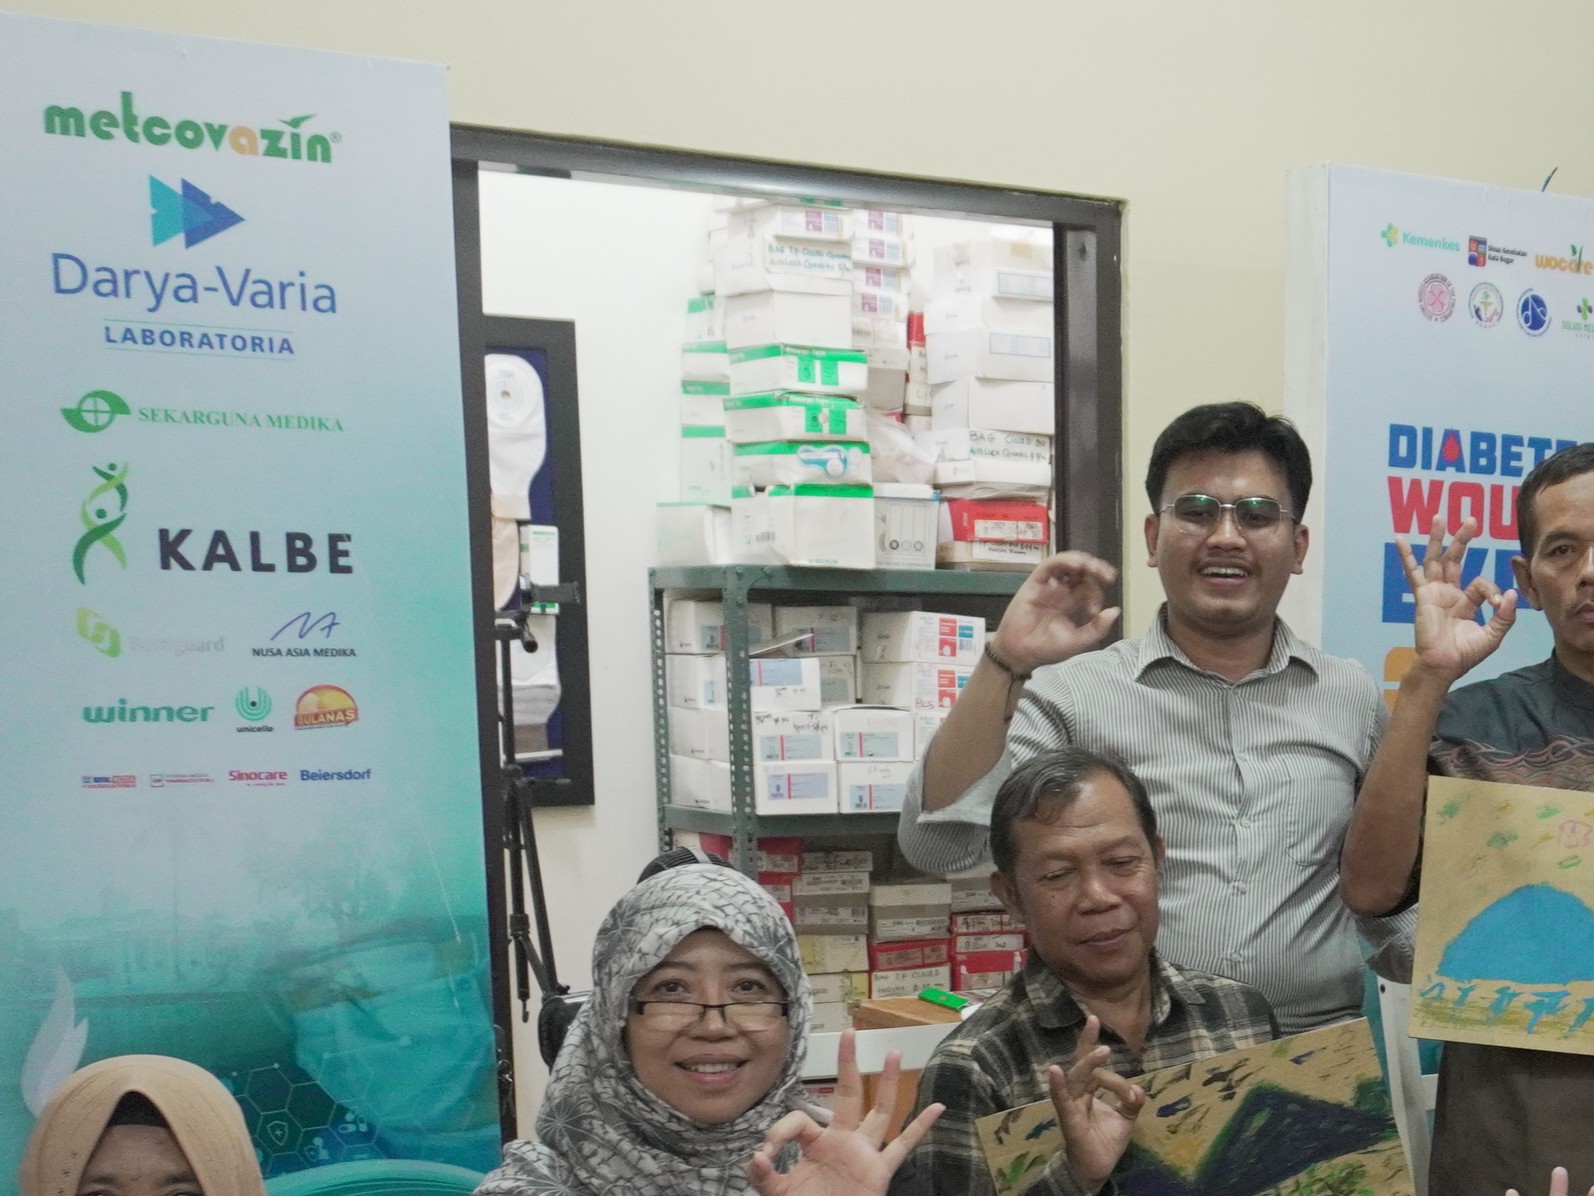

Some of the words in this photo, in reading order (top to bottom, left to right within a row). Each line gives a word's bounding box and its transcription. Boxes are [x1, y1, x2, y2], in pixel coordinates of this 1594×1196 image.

[1402, 231, 1461, 252] Kemenkes
[51, 252, 338, 314] Darya-Varia
[104, 326, 295, 355] LABORATORIA
[138, 407, 262, 428] SEKARGUNA
[266, 413, 344, 432] MEDIKA
[1388, 423, 1577, 477] DIABET
[157, 527, 354, 575] KALBE
[252, 647, 283, 658] NUSA
[285, 648, 311, 658] ASIA
[313, 648, 357, 658] MEDIKA
[82, 698, 214, 723] winner
[236, 725, 274, 733] unicelle
[229, 769, 288, 782] Sinocare
[301, 768, 371, 782] Beiersdorf
